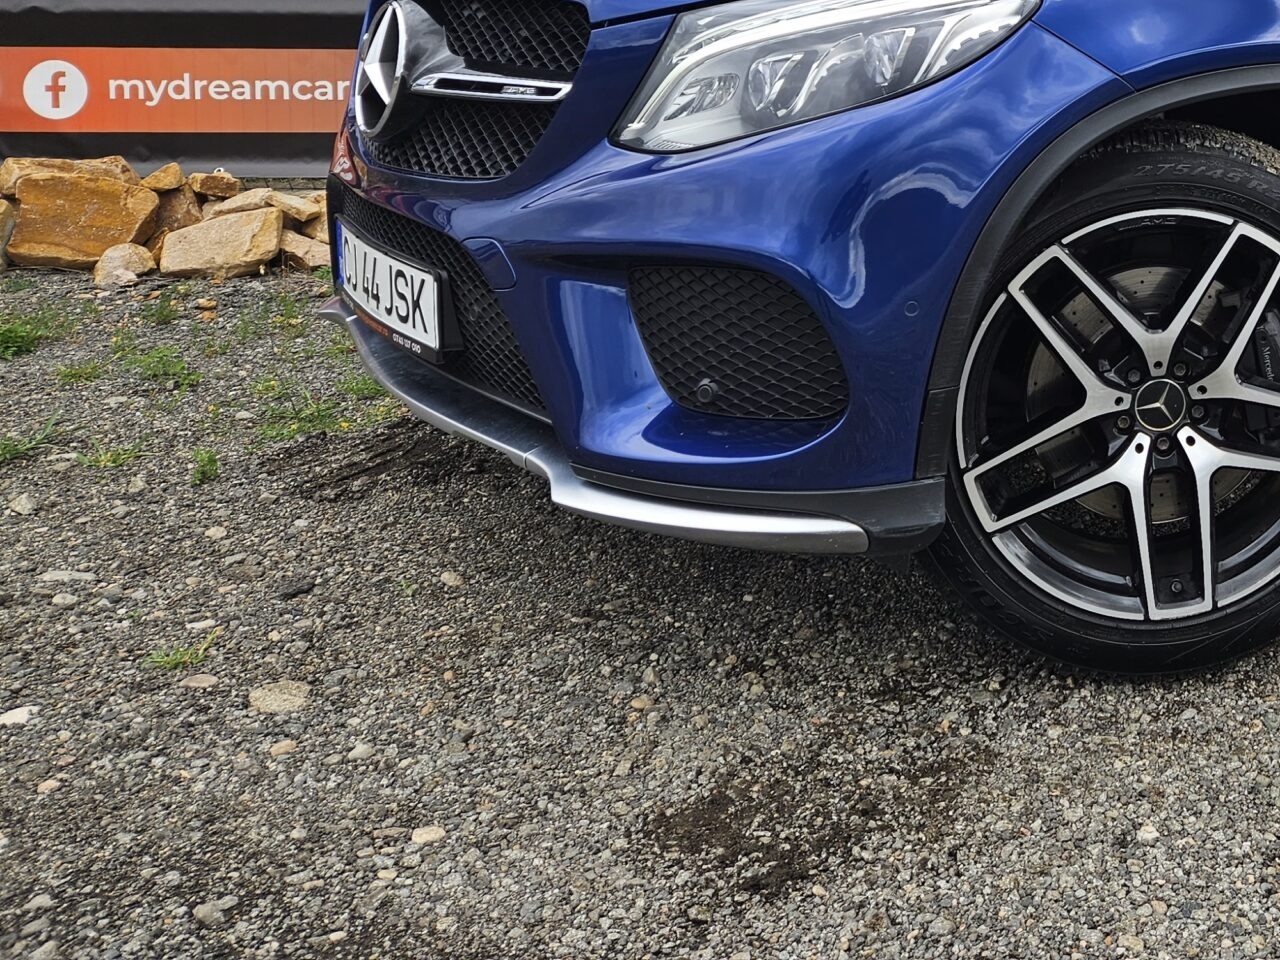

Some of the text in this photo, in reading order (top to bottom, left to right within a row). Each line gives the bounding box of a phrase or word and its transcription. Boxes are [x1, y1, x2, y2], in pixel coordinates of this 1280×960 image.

[108, 73, 350, 107] mydreamcar
[343, 235, 358, 292] CJ
[362, 251, 381, 310] 44
[384, 264, 428, 335] JSK
